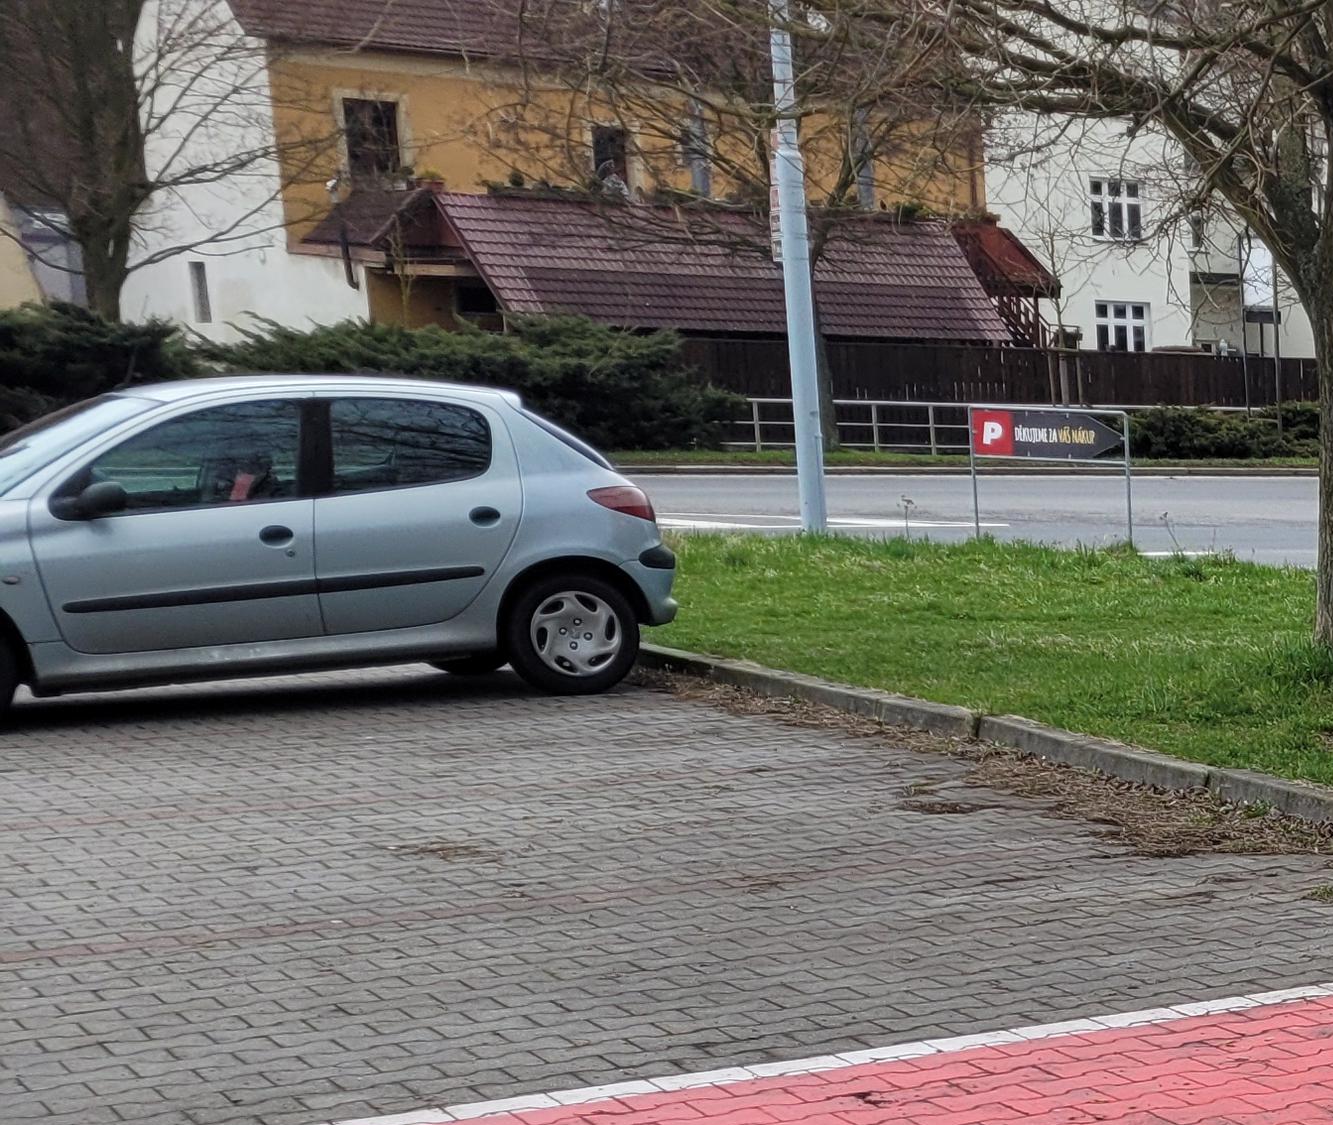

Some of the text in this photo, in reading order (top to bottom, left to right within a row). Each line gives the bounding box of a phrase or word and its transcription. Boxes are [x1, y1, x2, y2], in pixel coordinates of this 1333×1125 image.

[983, 421, 1003, 445] P
[1014, 424, 1096, 444] DĚKUJEME ZA VÁŠ NÁKUP
